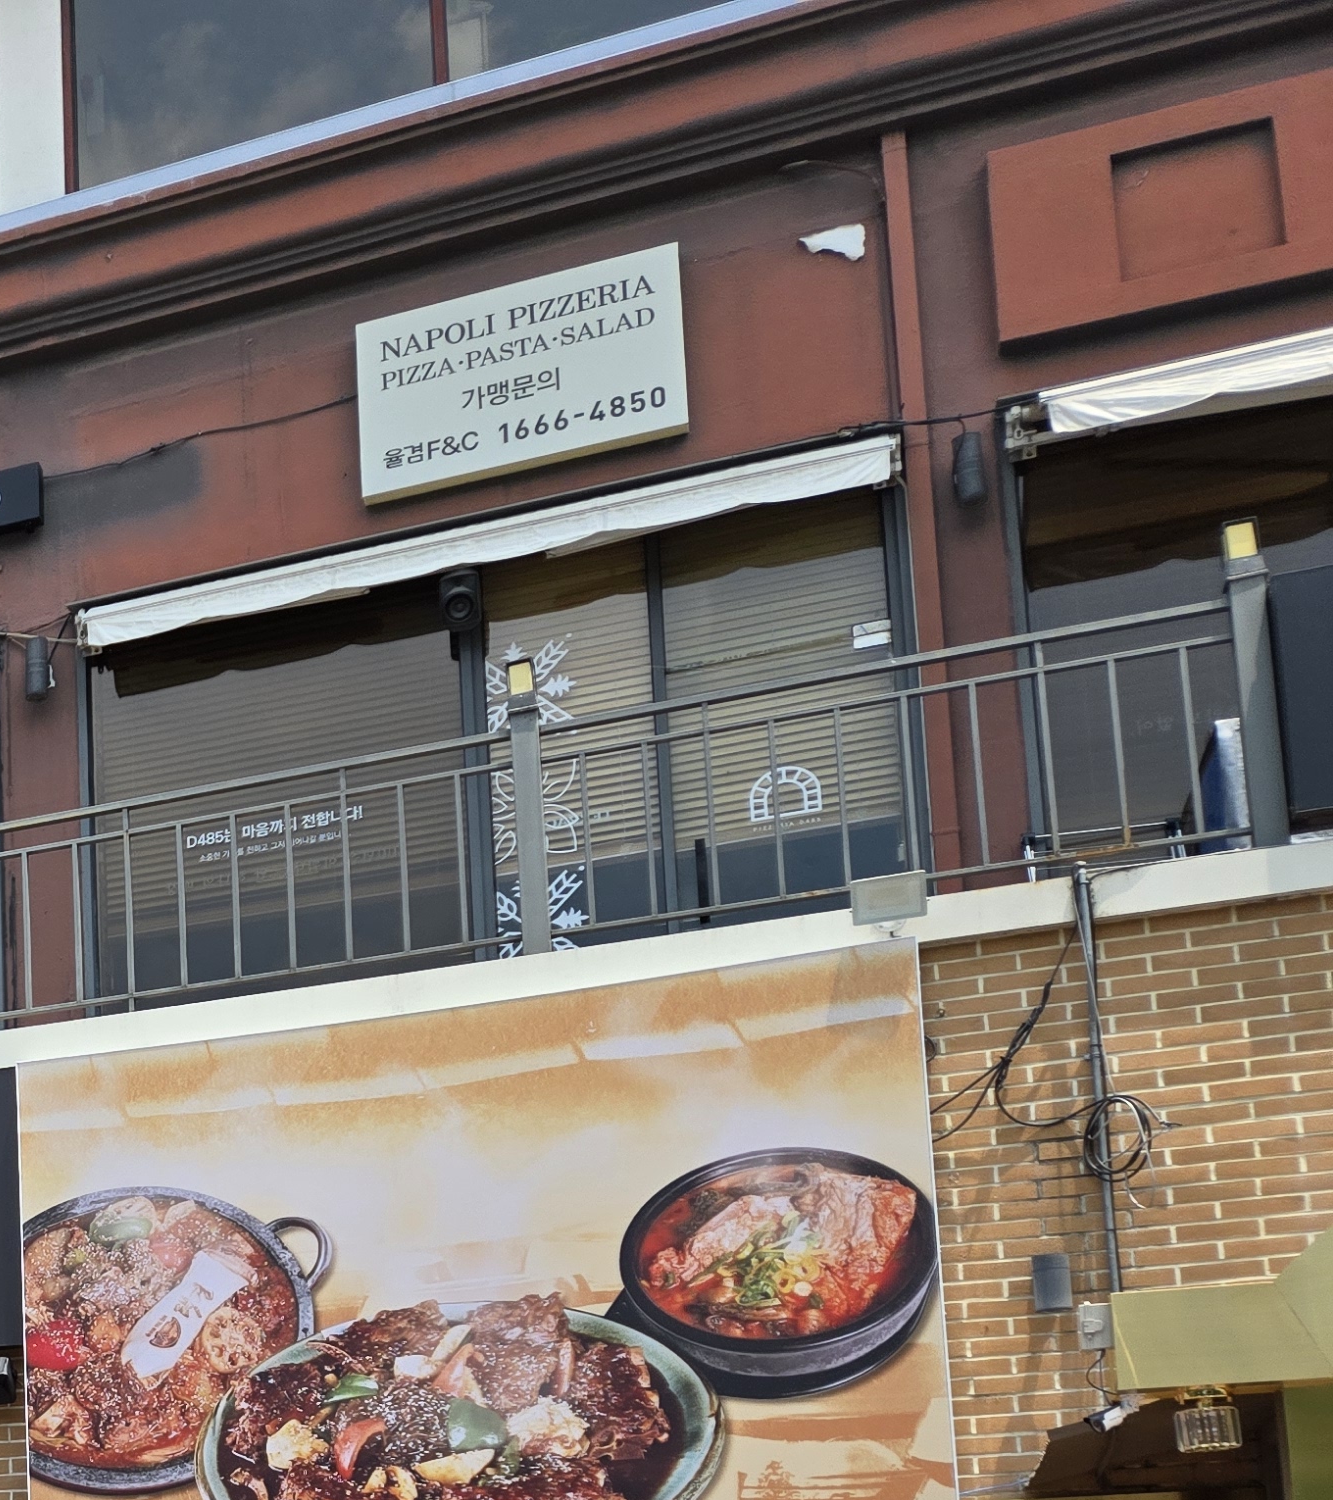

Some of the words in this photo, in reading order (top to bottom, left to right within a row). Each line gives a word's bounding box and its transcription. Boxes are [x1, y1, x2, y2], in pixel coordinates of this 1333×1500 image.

[380, 314, 496, 362] NAPOLI
[508, 275, 655, 329] PIZZERIA
[462, 367, 561, 410] 가맹문의
[383, 430, 480, 469] 율겸F&C
[498, 386, 667, 443] 1666-4850
[302, 804, 364, 829] 전합니다!
